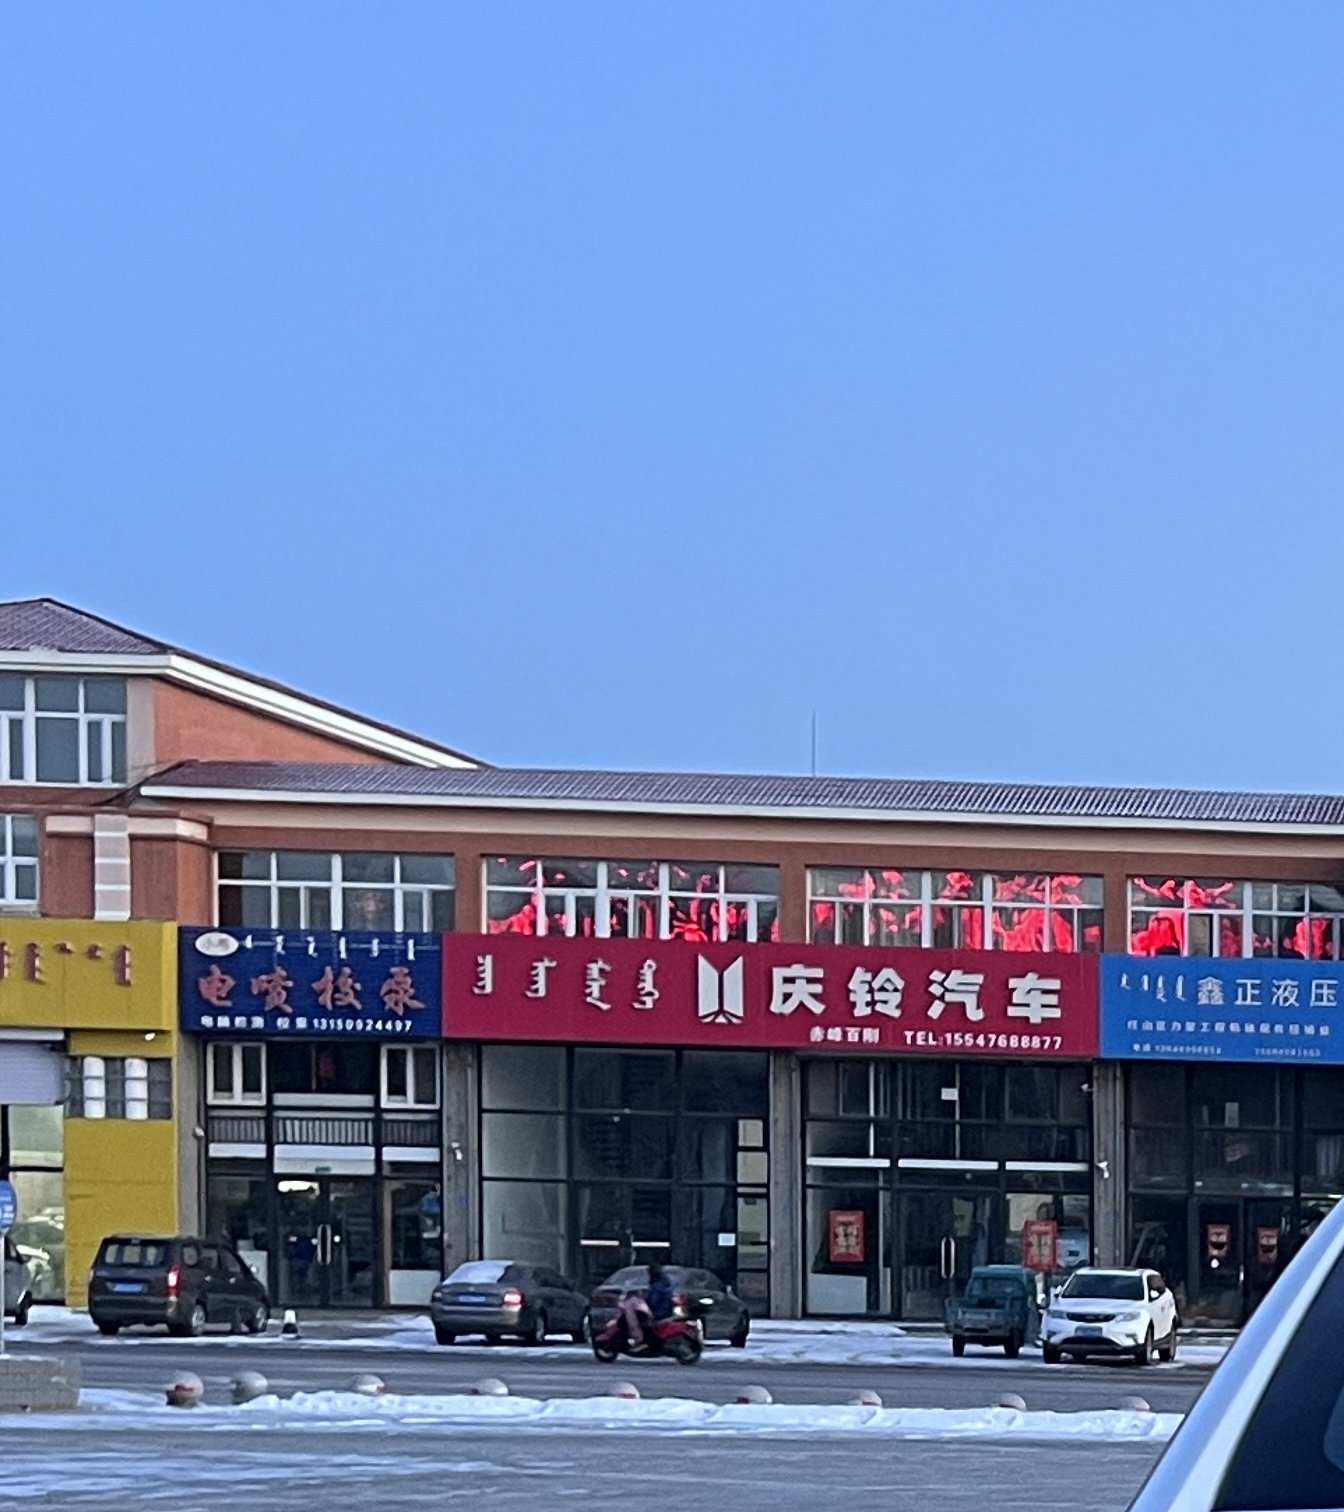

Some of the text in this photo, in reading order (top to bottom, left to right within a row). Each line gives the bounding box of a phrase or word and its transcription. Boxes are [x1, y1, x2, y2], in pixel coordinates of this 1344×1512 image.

[768, 963, 1063, 1024] 庆铃汽车
[1197, 976, 1339, 1007] 鑫正液压
